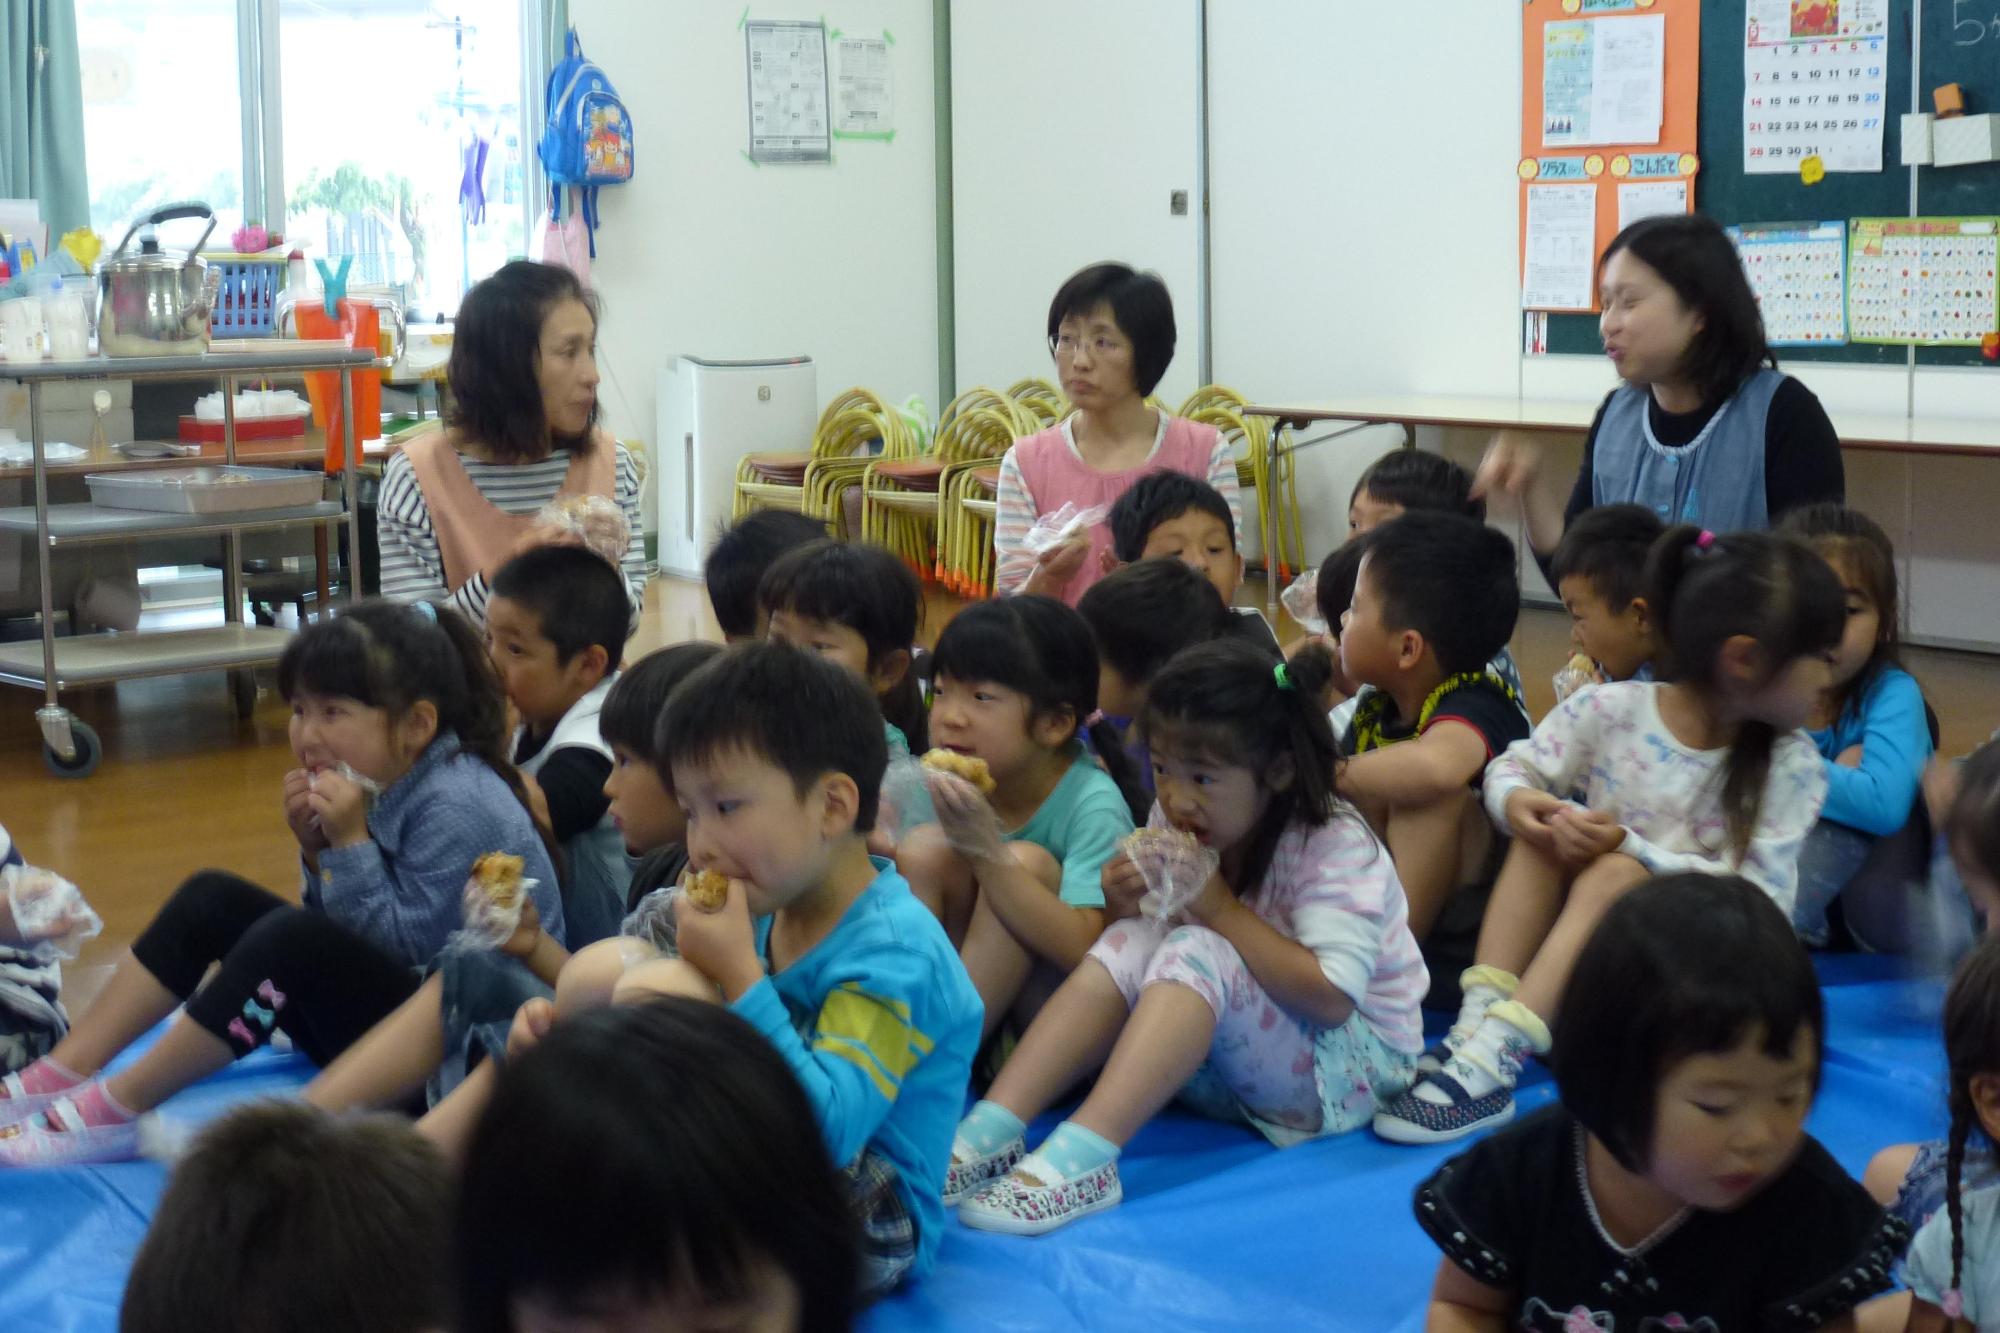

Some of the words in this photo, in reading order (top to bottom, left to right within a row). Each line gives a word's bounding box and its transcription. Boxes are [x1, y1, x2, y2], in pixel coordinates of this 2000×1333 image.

[1773, 45, 1778, 55] 1
[1791, 44, 1799, 54] 2
[1810, 43, 1818, 54] 3
[1829, 43, 1838, 52] 4
[1850, 43, 1858, 52] 5
[1870, 40, 1878, 49] 6
[1755, 72, 1761, 81] 7
[1771, 71, 1780, 80] 8
[1791, 70, 1799, 80] 9
[1808, 69, 1822, 79] 10
[1828, 68, 1840, 78] 11
[1848, 68, 1861, 77] 12
[1868, 67, 1879, 76] 13
[1751, 97, 1762, 106] 14
[1770, 97, 1781, 105] 15
[1788, 96, 1800, 105] 16
[1807, 95, 1819, 104] 17
[1827, 95, 1839, 103] 18
[1847, 94, 1859, 103] 19
[1865, 93, 1879, 102] 20
[1750, 123, 1762, 131] 21
[1767, 122, 1782, 130] 22
[1786, 121, 1800, 130] 23
[1804, 121, 1818, 129] 24
[1824, 120, 1837, 129] 25
[1843, 120, 1858, 128] 26
[1863, 119, 1878, 128] 27
[1751, 147, 1763, 156] 28
[1769, 147, 1782, 155] 29
[1787, 147, 1801, 155] 30
[1806, 147, 1819, 155] 31
[1633, 155, 1676, 175] こんだて
